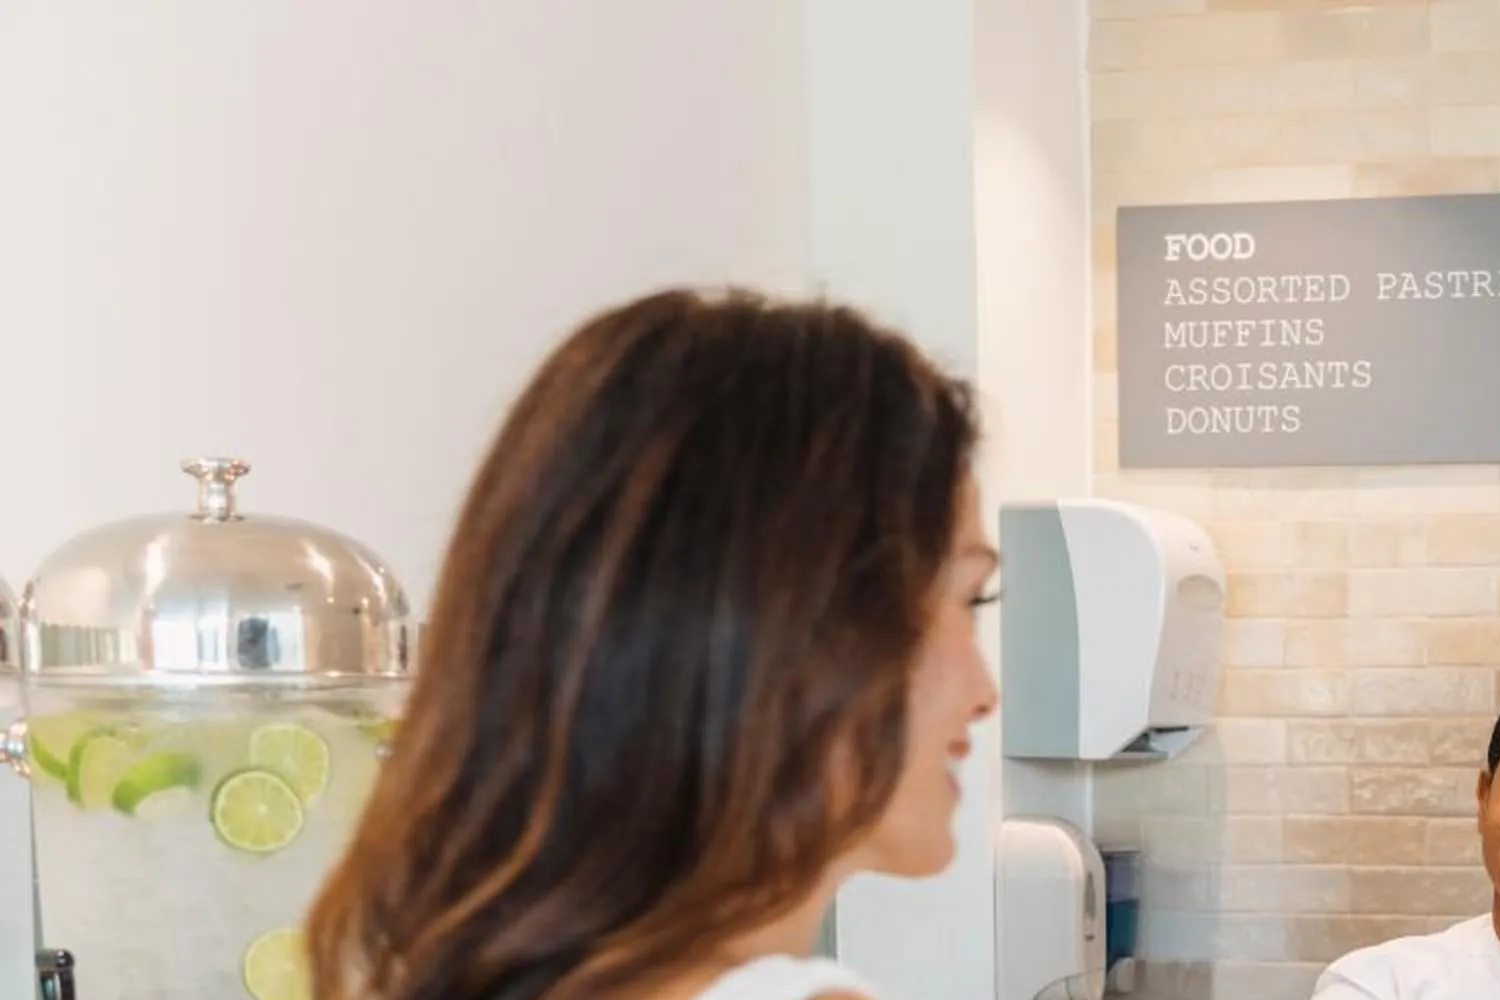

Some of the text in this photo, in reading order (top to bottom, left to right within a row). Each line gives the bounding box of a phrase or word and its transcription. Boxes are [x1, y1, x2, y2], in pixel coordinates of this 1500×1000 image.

[1164, 232, 1255, 262] FOOD
[1164, 274, 1350, 305] ASSORTED
[1164, 318, 1325, 349] MUFFINS
[1165, 360, 1372, 392] CROISANTS
[1166, 405, 1301, 434] DONUTS
